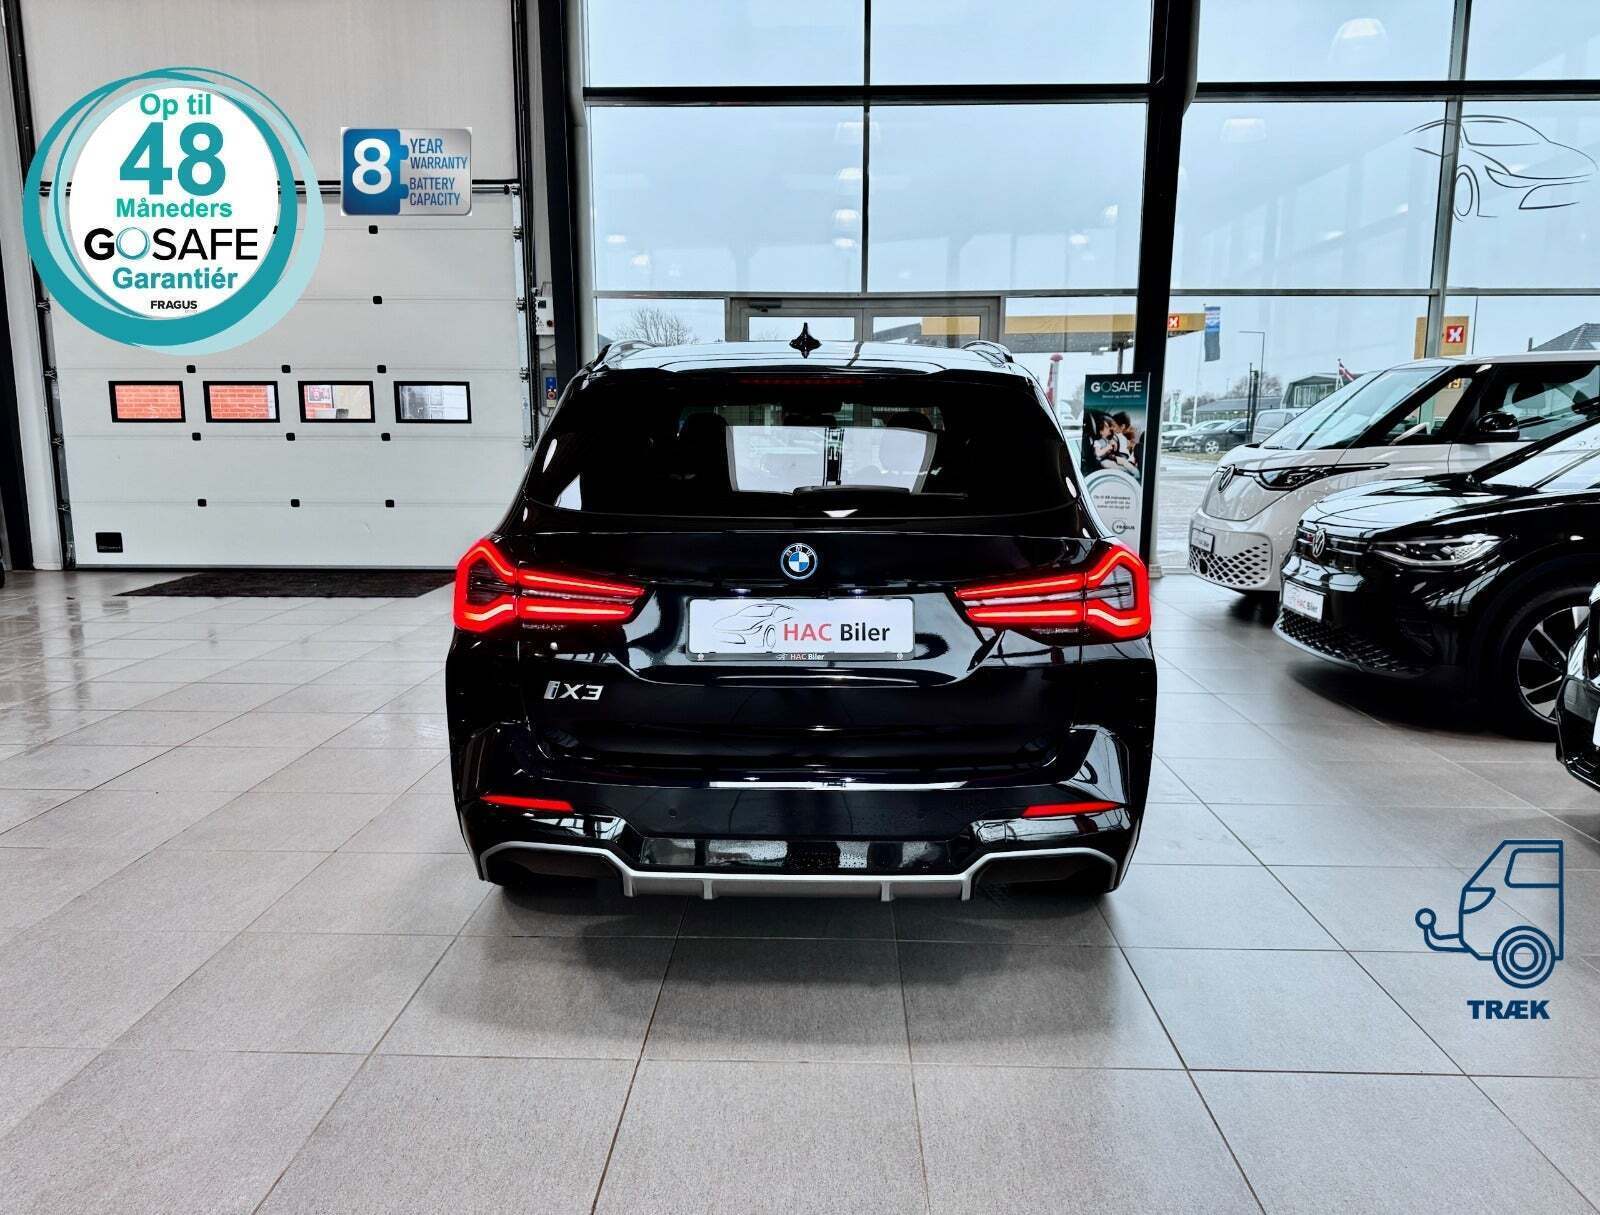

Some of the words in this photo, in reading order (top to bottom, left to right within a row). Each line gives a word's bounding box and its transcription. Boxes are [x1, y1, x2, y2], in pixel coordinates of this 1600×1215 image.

[1090, 380, 1142, 392] GOSAFE
[784, 623, 832, 641] HAC
[840, 622, 891, 641] Biler
[808, 652, 824, 660] Biler
